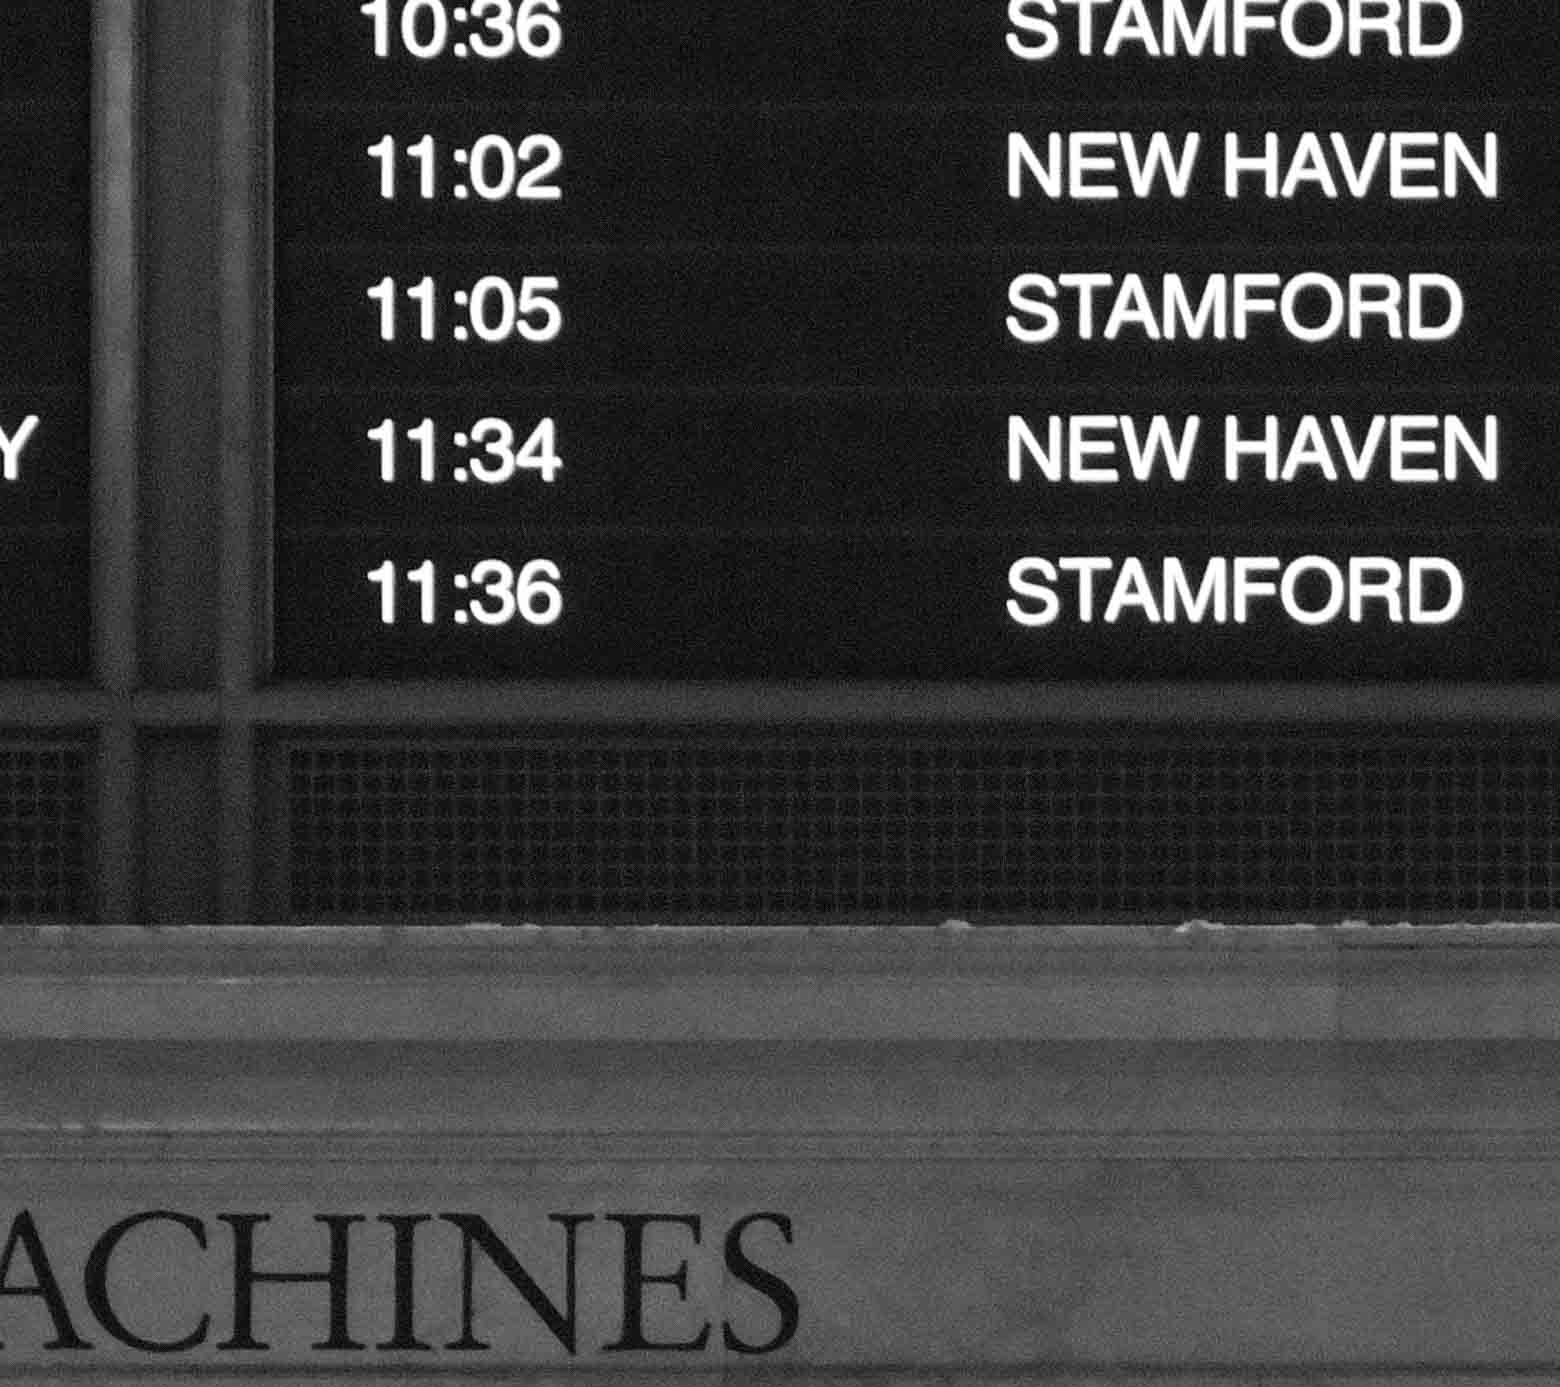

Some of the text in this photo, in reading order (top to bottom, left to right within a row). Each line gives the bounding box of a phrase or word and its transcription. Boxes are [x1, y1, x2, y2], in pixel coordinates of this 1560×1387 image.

[359, 0, 564, 61] 10:36
[1004, 0, 1465, 62] STAMFORD
[366, 132, 564, 202] 11:02
[1006, 130, 1499, 201] NEW HAVEN
[365, 274, 564, 344] 11:05
[1004, 270, 1465, 345] STAMFORD
[365, 415, 565, 486] 11:34
[1006, 413, 1500, 484] NEW HAVEN
[365, 557, 564, 627] 11:36
[1004, 553, 1466, 628] STAMFORD
